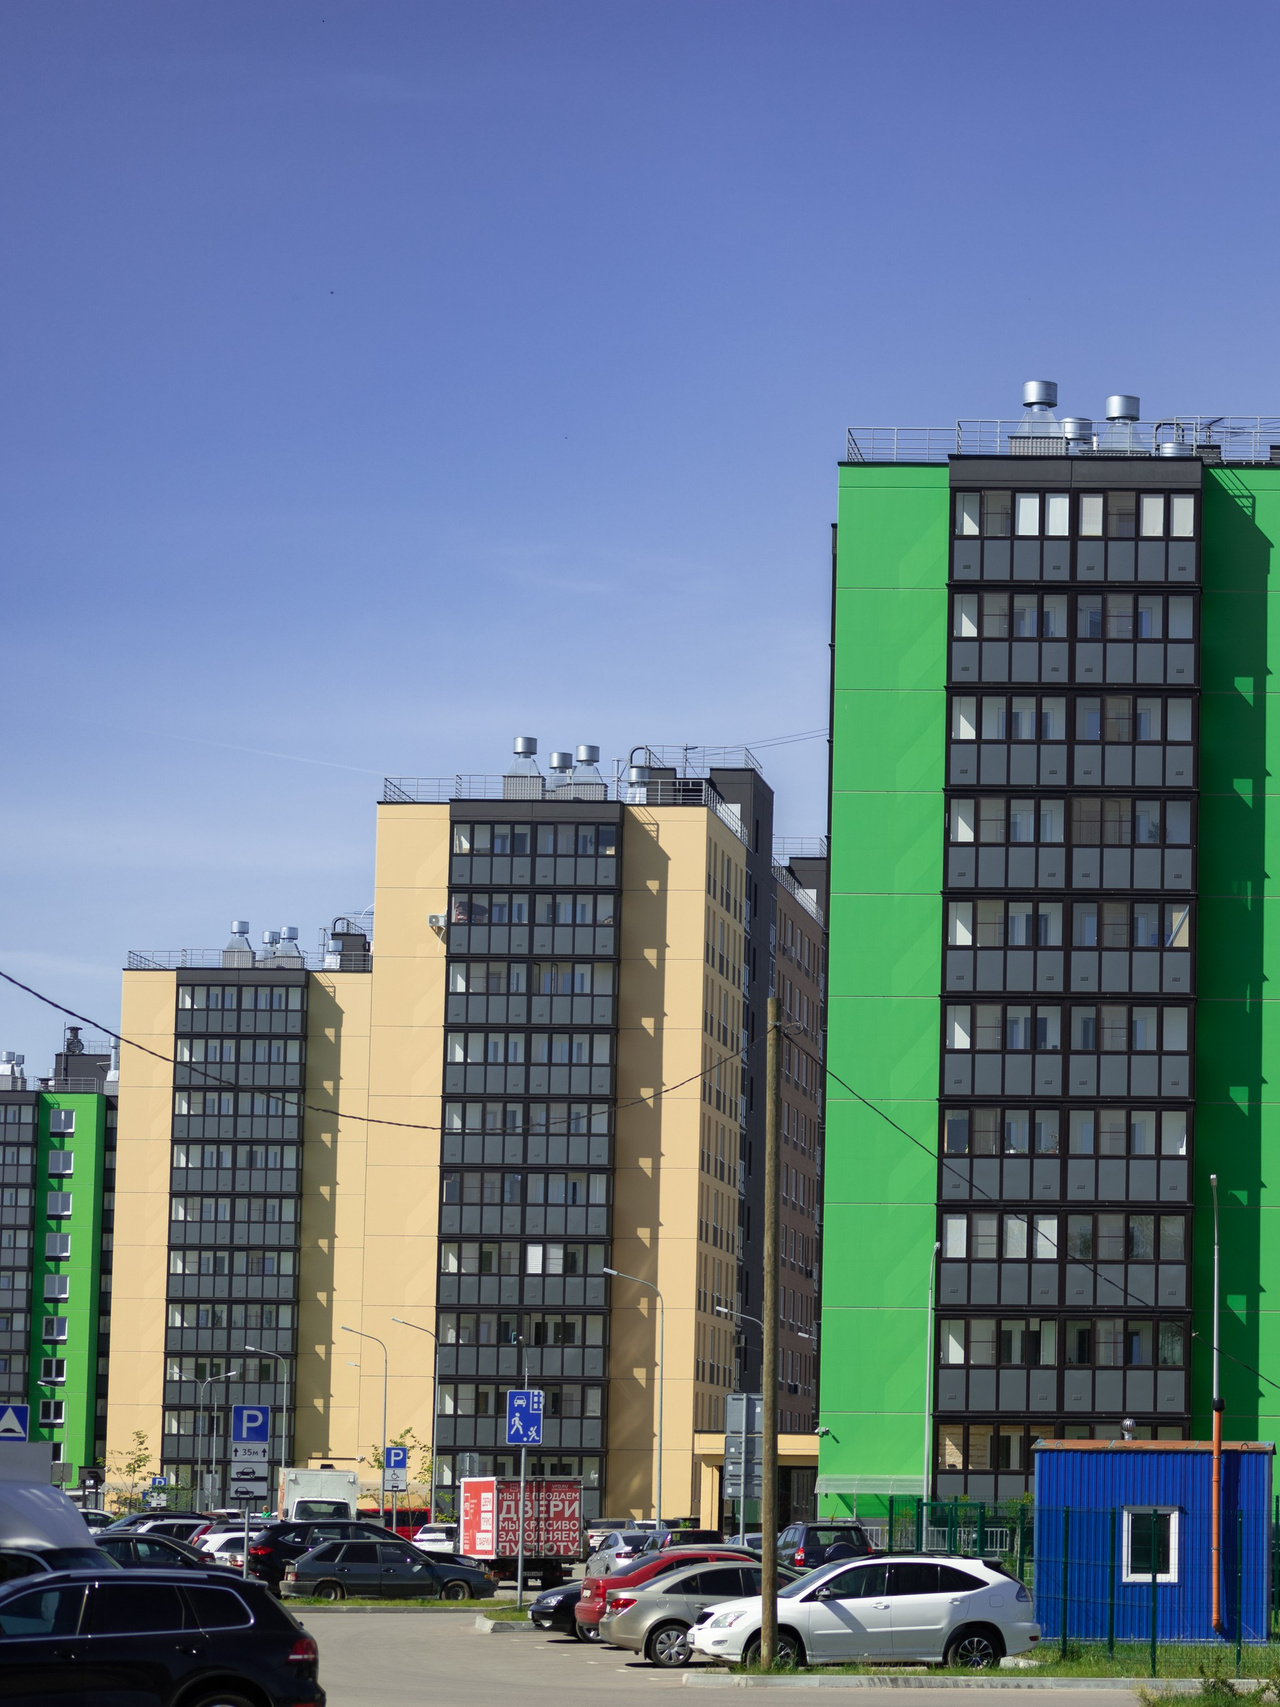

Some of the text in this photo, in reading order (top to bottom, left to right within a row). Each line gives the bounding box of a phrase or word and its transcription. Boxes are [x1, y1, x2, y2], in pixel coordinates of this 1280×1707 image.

[242, 1410, 263, 1438] P
[391, 1450, 403, 1467] P
[499, 1492, 515, 1500] МЫ
[532, 1492, 579, 1501] ПРОДАЕМ
[500, 1501, 579, 1520] ДВЕРИ
[499, 1521, 519, 1530] МЫ
